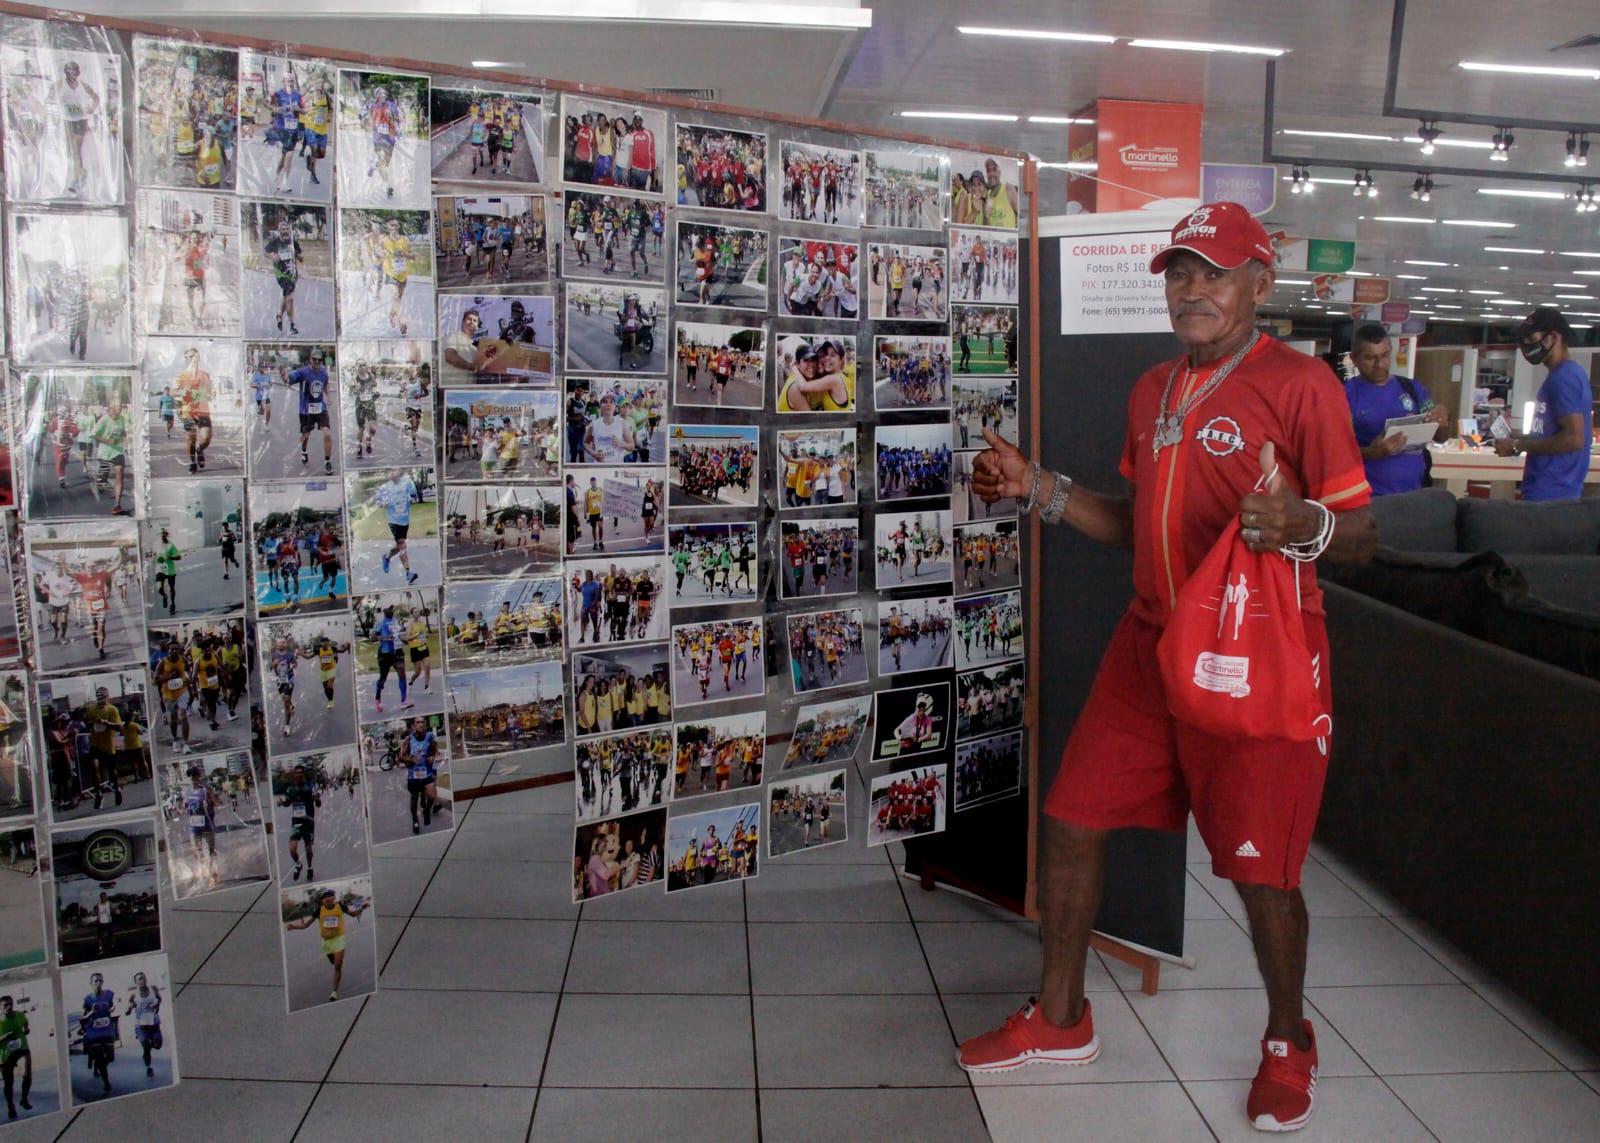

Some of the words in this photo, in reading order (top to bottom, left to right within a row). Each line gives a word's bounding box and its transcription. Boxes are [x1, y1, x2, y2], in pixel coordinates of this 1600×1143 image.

[1127, 151, 1178, 162] martinello
[1216, 178, 1262, 189] ENTREGA
[1072, 245, 1127, 256] CORRIDA
[1131, 244, 1147, 254] DE
[1151, 243, 1170, 253] RE
[1086, 263, 1114, 273] Fotos
[1116, 262, 1130, 273] R$
[1133, 262, 1148, 274] 10,
[1082, 307, 1103, 315] Fone:
[1104, 307, 1120, 317] (65)
[1122, 307, 1168, 315] 99971-5004
